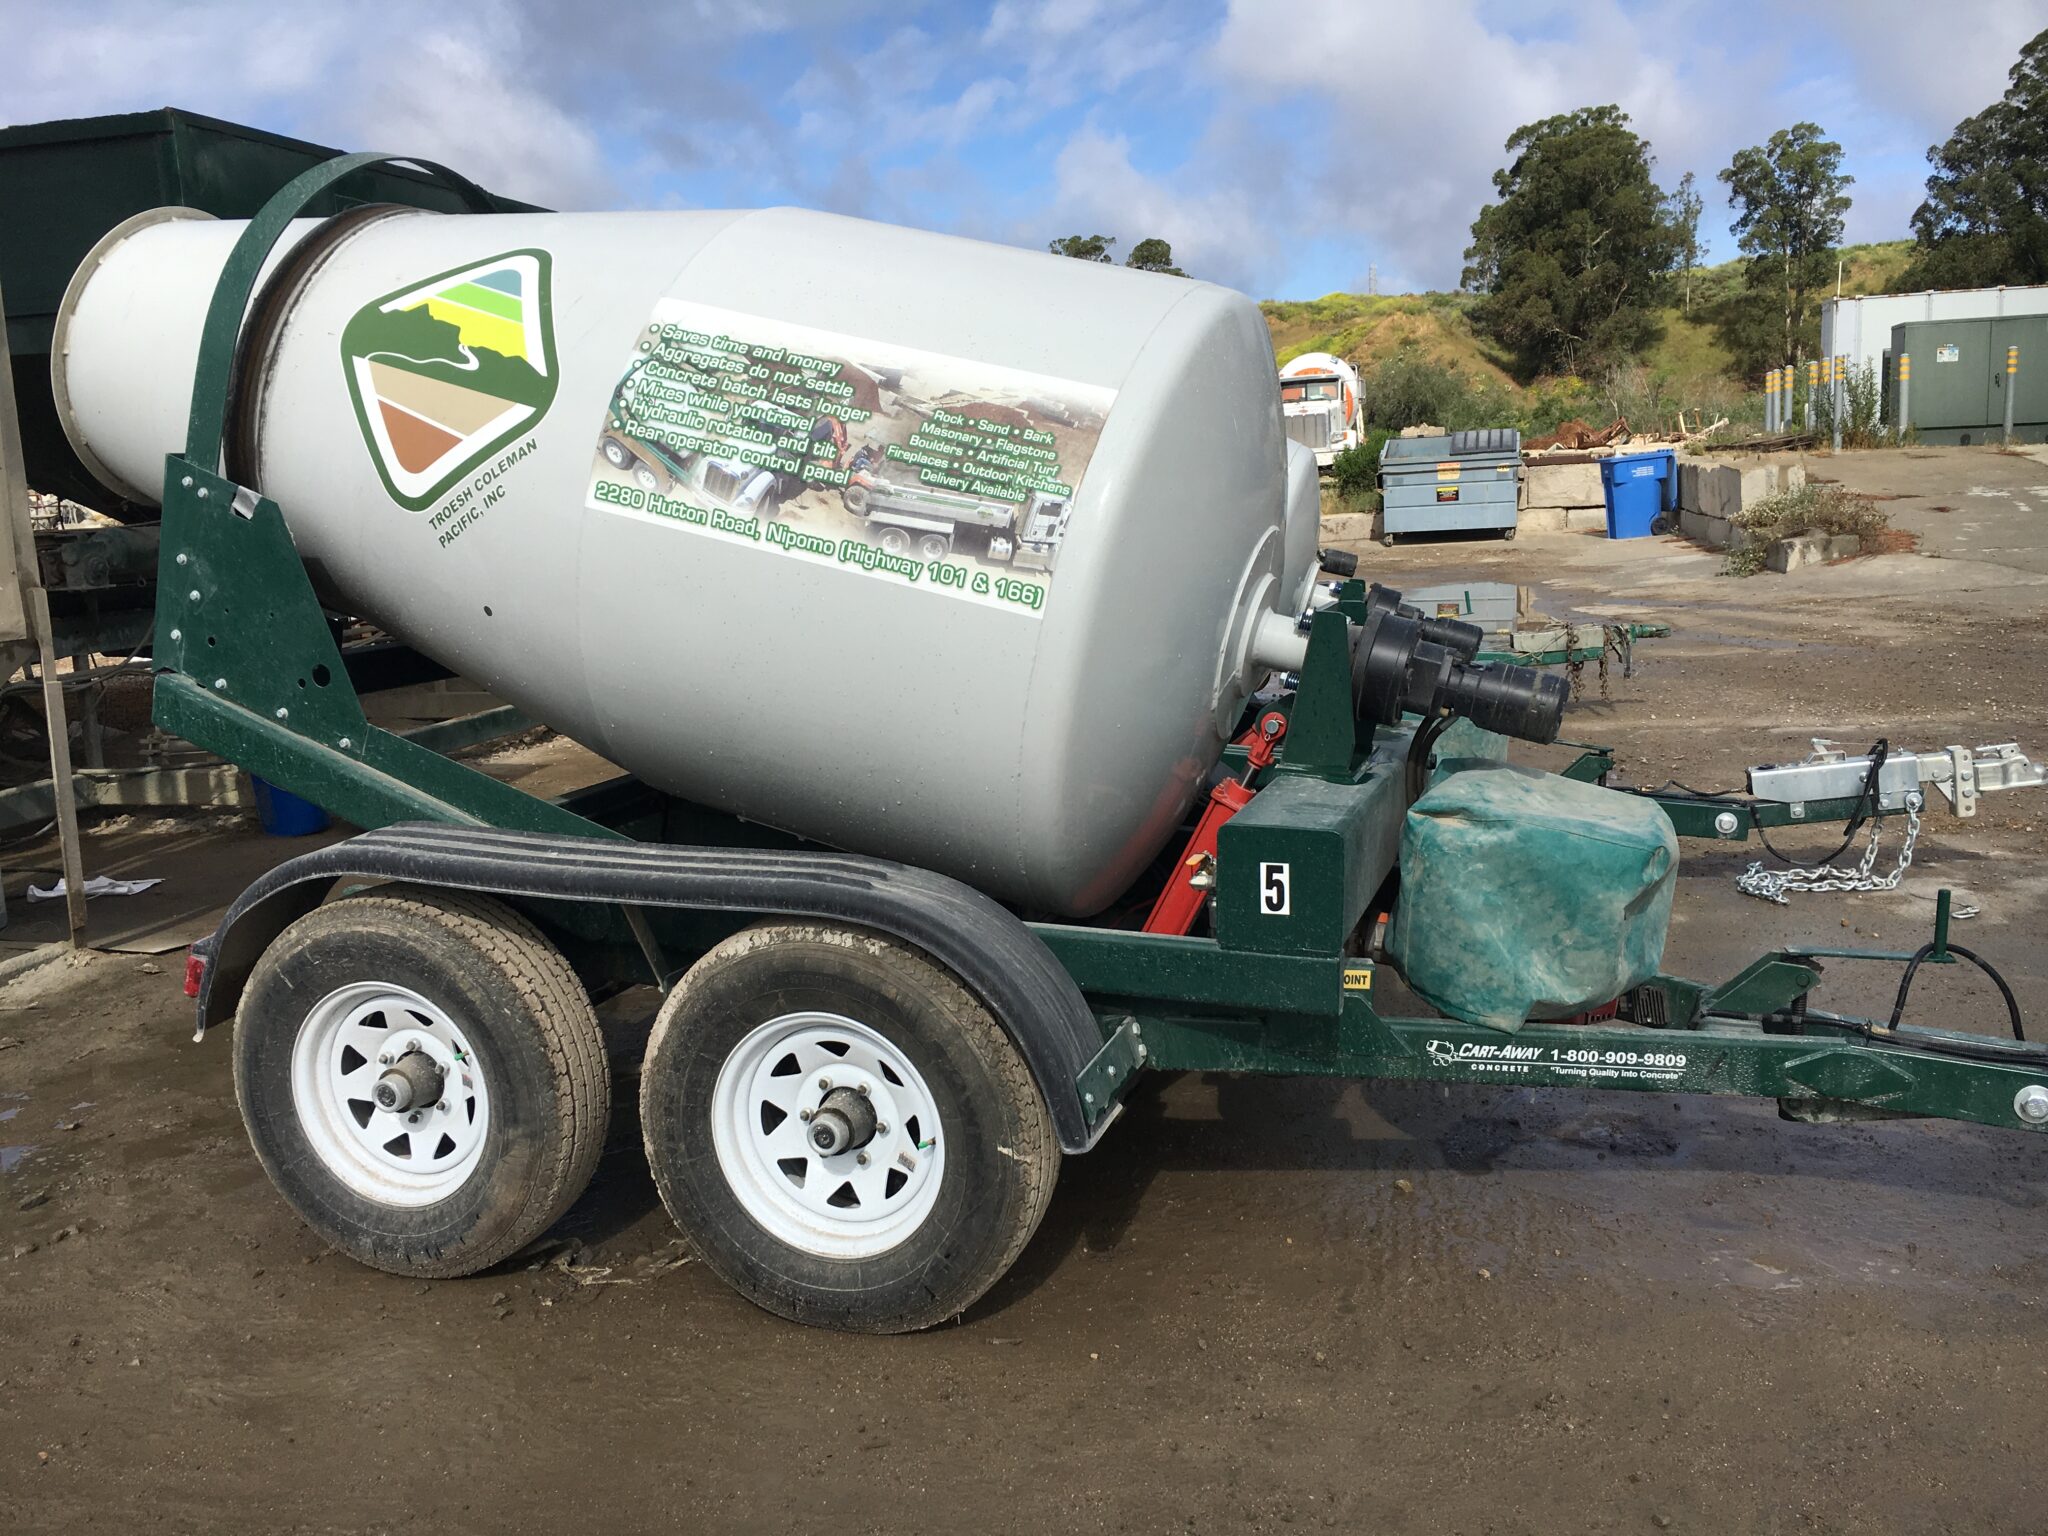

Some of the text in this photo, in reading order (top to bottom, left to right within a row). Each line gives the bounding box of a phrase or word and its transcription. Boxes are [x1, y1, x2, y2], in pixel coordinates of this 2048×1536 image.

[653, 343, 854, 397] Aggregates do not settle
[662, 325, 843, 377] Saves time and money
[637, 379, 815, 431] Mixes while you travel
[644, 361, 870, 423] Concrete batch lasts longer
[625, 419, 850, 485] Rear operator control panel
[631, 399, 838, 459] Hydraulic rotation and tilt
[921, 422, 1056, 461] Masonary Flagstone
[934, 410, 1054, 444] Rock Sand Bark
[886, 445, 1071, 496] Fireplaces Outdoor Kitchens
[909, 434, 1058, 476] Boulders Artificial Turf
[429, 438, 537, 530] TROESH COLEMAN
[920, 469, 1026, 502] Delivery Available
[439, 484, 506, 548] PACIFIC, INC
[595, 482, 1044, 608] 2280 Hutton Road, Nipomo (Highway 101 & 166)
[1265, 864, 1285, 912] 5
[1471, 1063, 1529, 1073] CONCRETE
[1550, 1048, 1687, 1067] 1-800-909-9809
[1589, 1068, 1620, 1079] Quality
[1621, 1069, 1638, 1078] into
